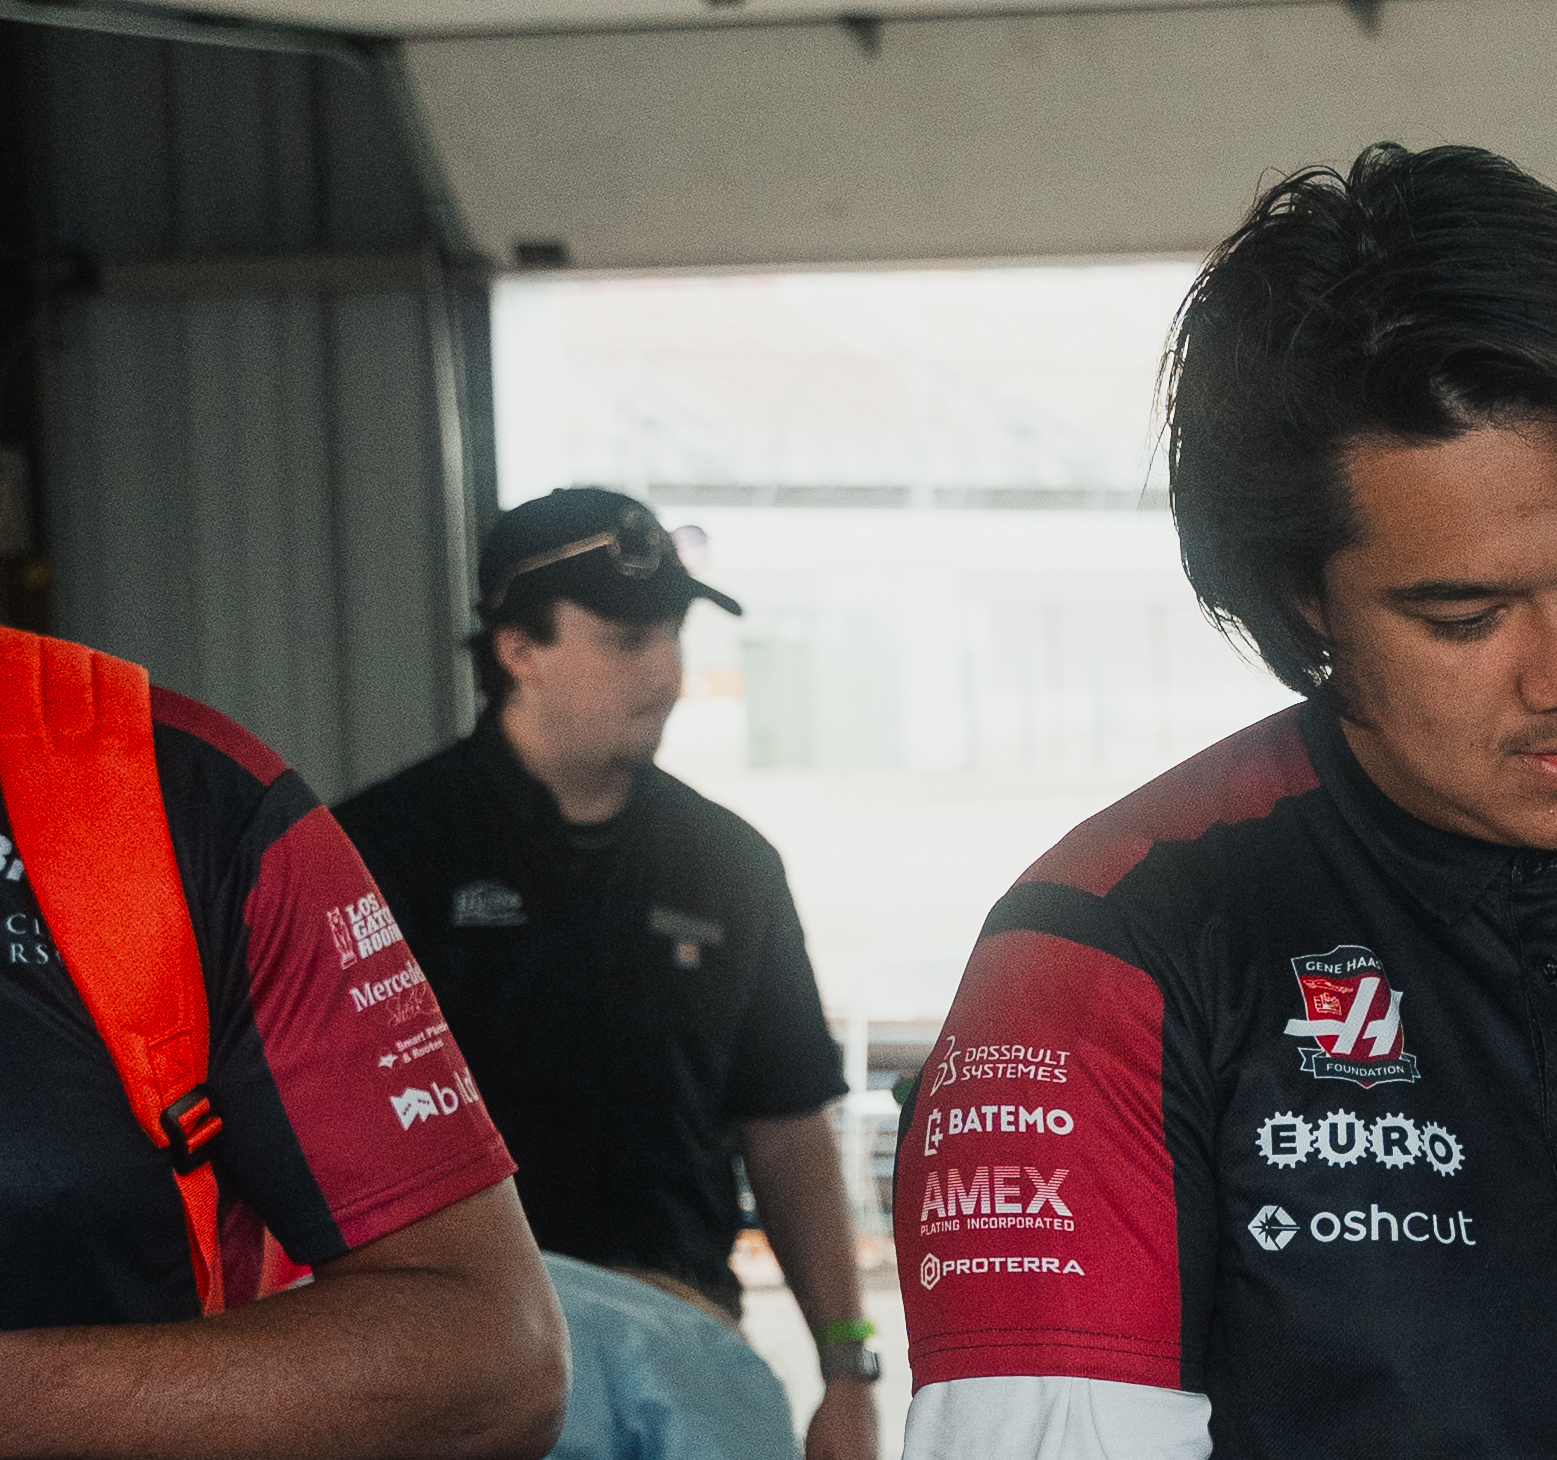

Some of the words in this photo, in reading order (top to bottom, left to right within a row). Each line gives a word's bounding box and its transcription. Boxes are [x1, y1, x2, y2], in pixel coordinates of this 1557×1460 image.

[346, 892, 380, 925] LOS
[1305, 960, 1343, 974] GENE
[964, 1044, 1071, 1066] DASSAULT
[1326, 1062, 1406, 1077] FOUNDATION
[948, 1104, 1075, 1136] BATEMO
[1263, 1116, 1459, 1172] EURO
[920, 1165, 1074, 1222] AMEX
[919, 1218, 961, 1237] PLATING
[966, 1216, 1076, 1232] INCORPORATED
[1309, 1203, 1477, 1246] oshcut
[941, 1256, 1086, 1277] PROTERRA
